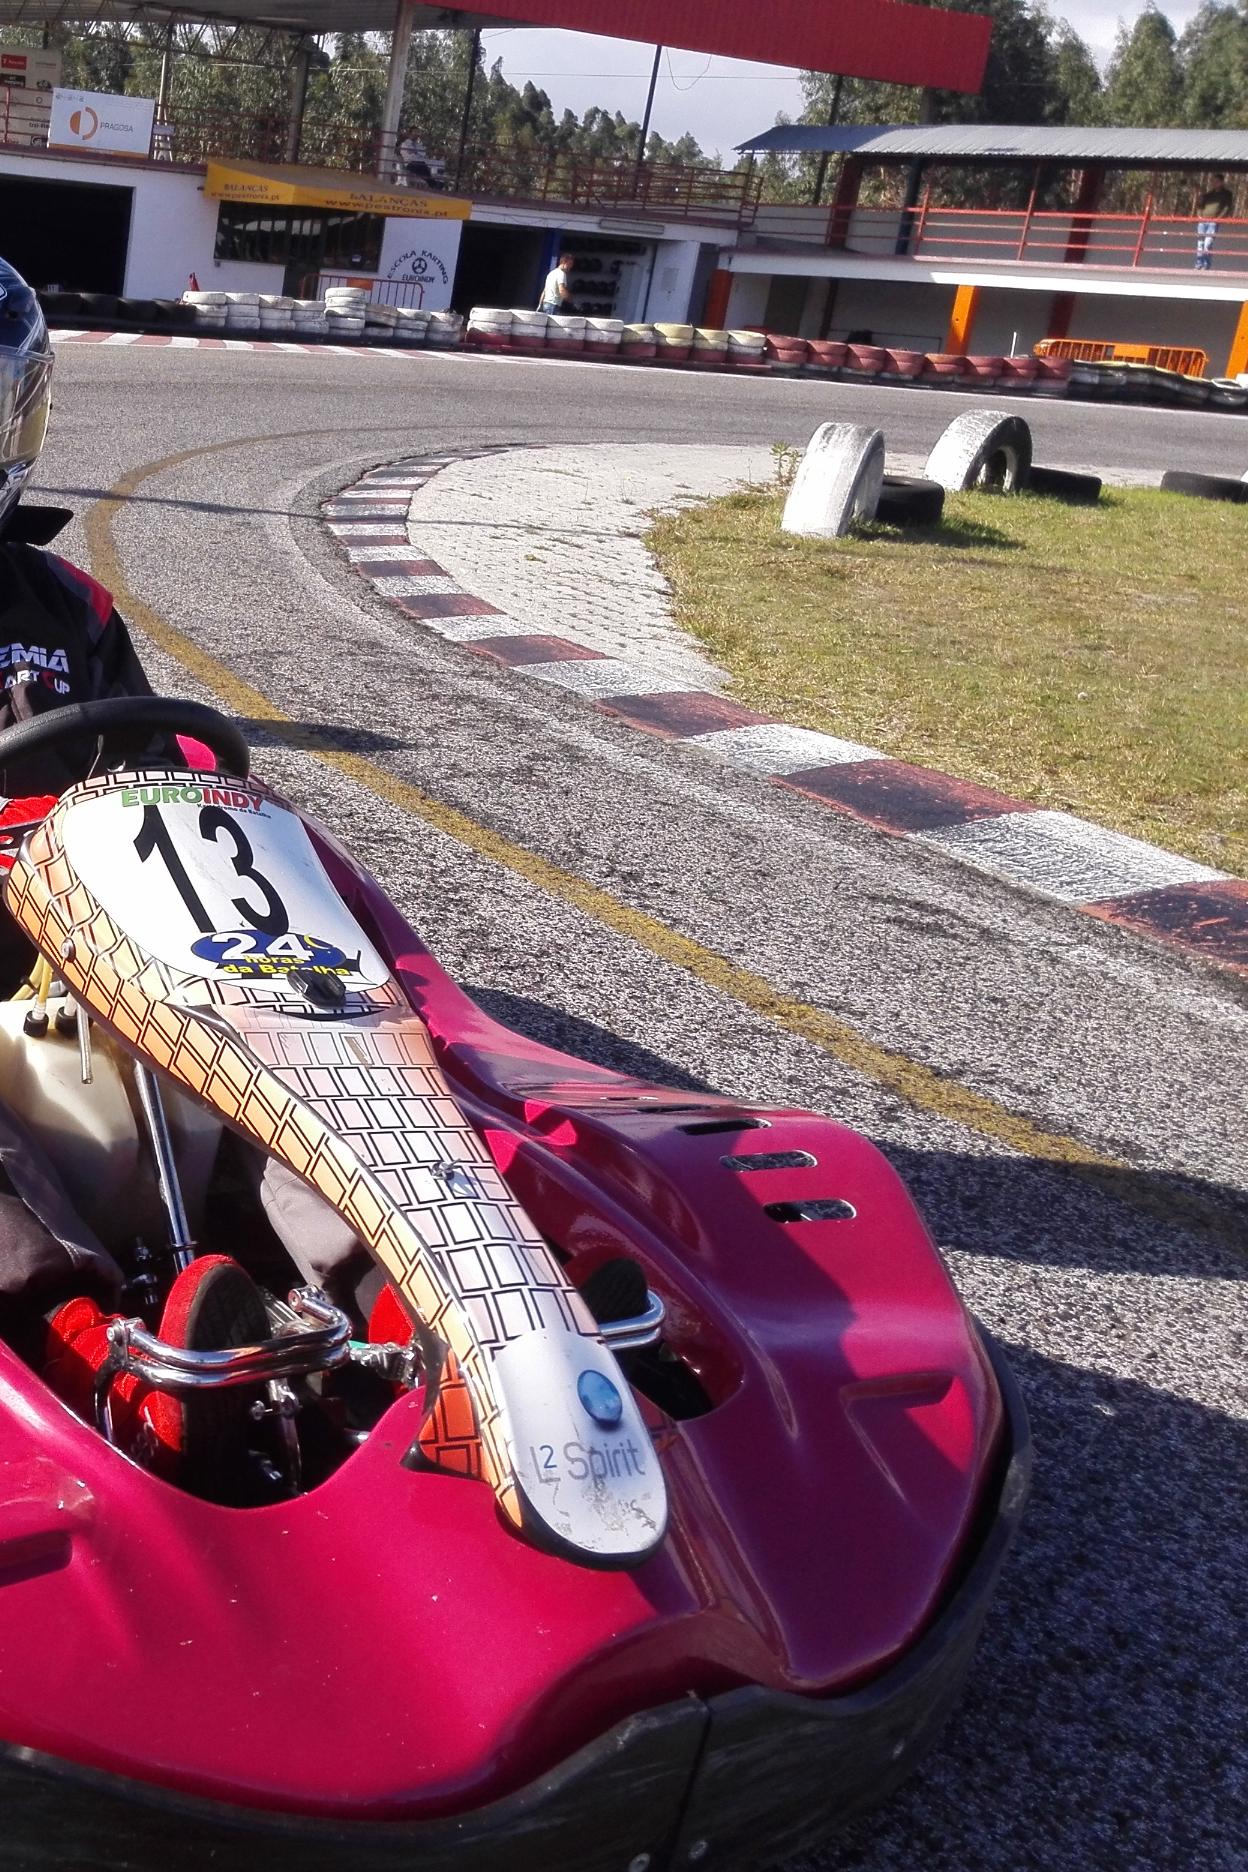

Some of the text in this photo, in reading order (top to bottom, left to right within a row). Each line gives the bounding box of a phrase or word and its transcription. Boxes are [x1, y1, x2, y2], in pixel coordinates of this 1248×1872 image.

[100, 121, 134, 132] PRAGOSA
[387, 250, 449, 284] ESCOLA KARTING
[121, 786, 263, 811] EUROINDY
[133, 803, 290, 937] 13
[211, 932, 315, 961] 24
[243, 954, 305, 964] horas
[223, 964, 253, 974] da
[563, 1438, 646, 1489] Spirit
